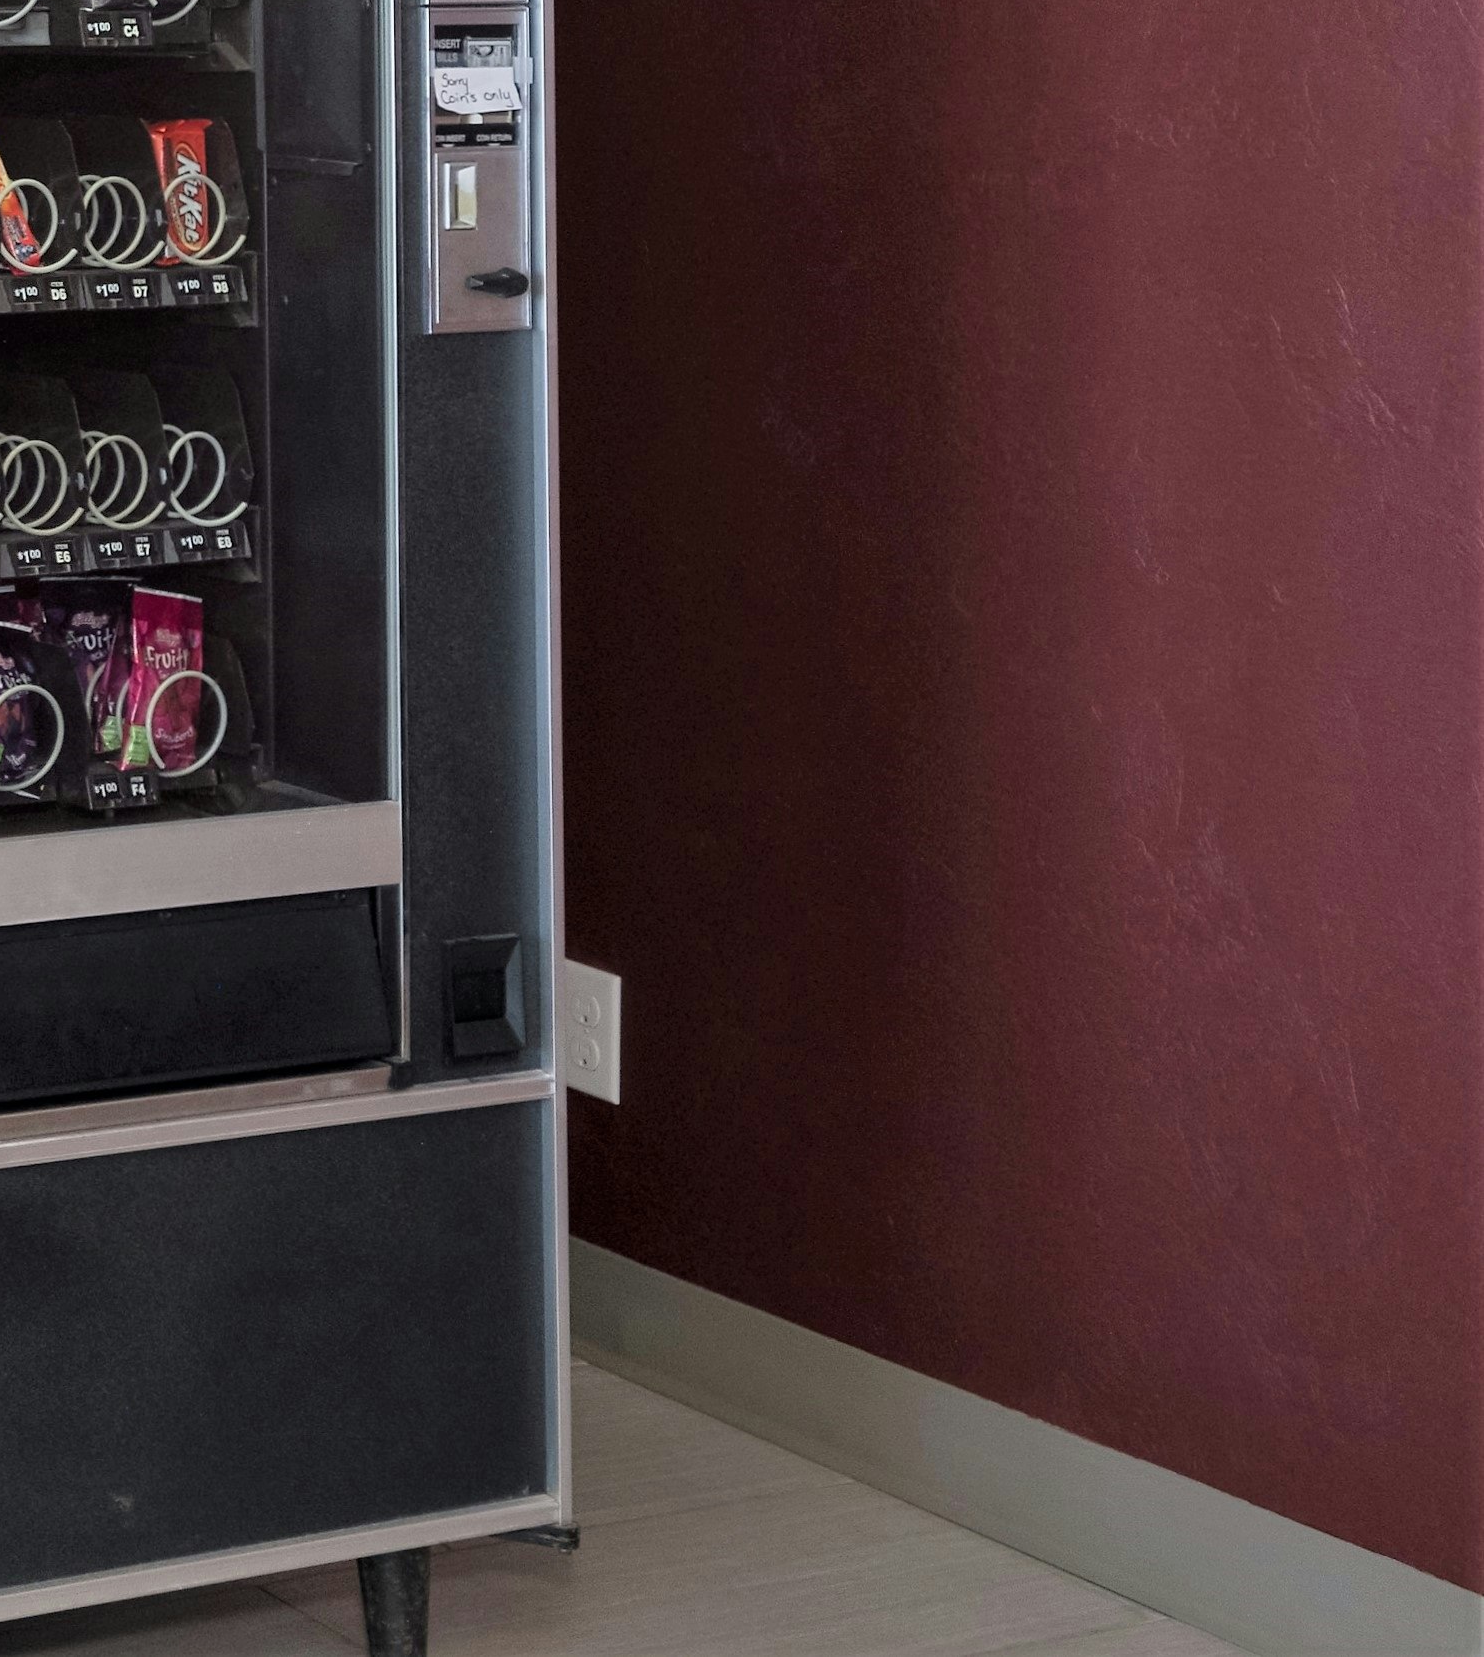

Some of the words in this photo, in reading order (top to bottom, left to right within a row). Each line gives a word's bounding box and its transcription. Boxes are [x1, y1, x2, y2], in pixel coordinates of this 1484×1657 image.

[123, 25, 139, 37] C4
[442, 73, 468, 94] Sorry
[484, 88, 514, 108] only
[133, 285, 148, 298] D7
[213, 281, 229, 294] D8
[51, 288, 67, 301] D6
[216, 536, 232, 549] E8
[136, 544, 151, 557] E7
[55, 551, 72, 564] E6
[131, 784, 146, 796] F4
